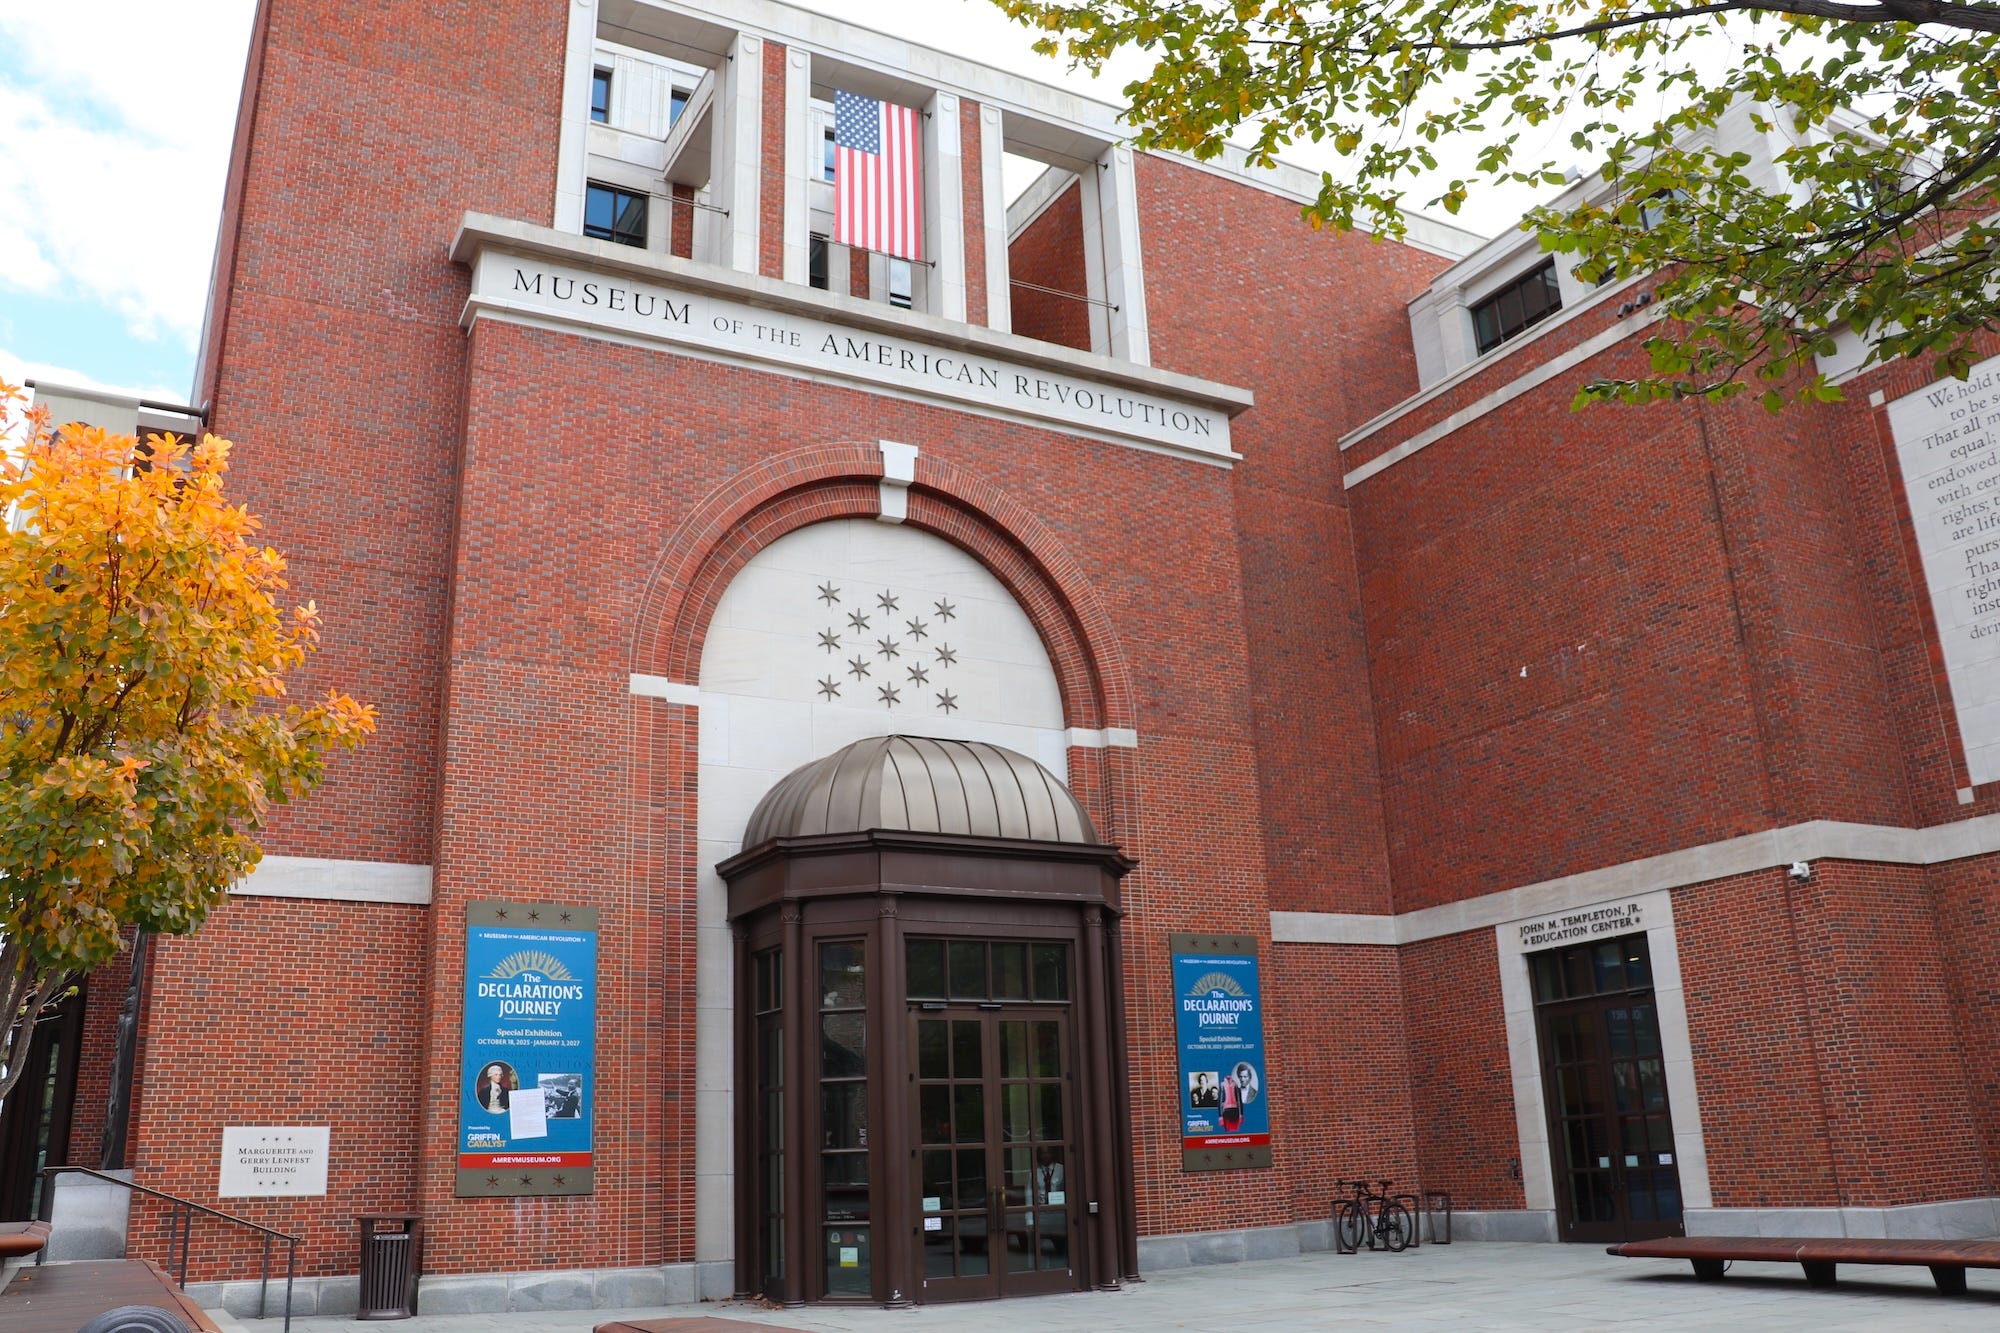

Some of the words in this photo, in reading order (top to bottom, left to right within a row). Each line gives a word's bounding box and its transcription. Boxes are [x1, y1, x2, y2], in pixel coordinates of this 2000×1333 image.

[512, 269, 691, 324] MUSEUM
[713, 317, 743, 334] OF
[753, 324, 801, 347] THE
[821, 333, 999, 389] AMERICAN
[1014, 374, 1211, 436] REVOLUTION
[1926, 387, 1953, 408] We
[1957, 372, 1992, 399] hold
[1951, 409, 1965, 420] to
[1968, 400, 1987, 413] be
[1922, 429, 1959, 449] That
[1963, 416, 1981, 435] all
[1951, 431, 1996, 459] equal;
[1928, 451, 1998, 489] endowed
[1937, 484, 1971, 504] with
[1977, 474, 2000, 491] cer
[1952, 526, 1974, 540] are
[1520, 922, 1544, 937] JOHN
[1548, 920, 1559, 929] M.
[1561, 907, 1625, 926] TEMPLETON,
[1627, 903, 1643, 916] JR.
[1530, 926, 1587, 945] EDUCATION
[1592, 917, 1633, 933] CENTER
[522, 973, 540, 983] The
[498, 1000, 561, 1017] JOURNEY
[1199, 1013, 1239, 1027] JOURNEY
[497, 1029, 523, 1037] Special
[467, 1140, 507, 1148] CATALYST
